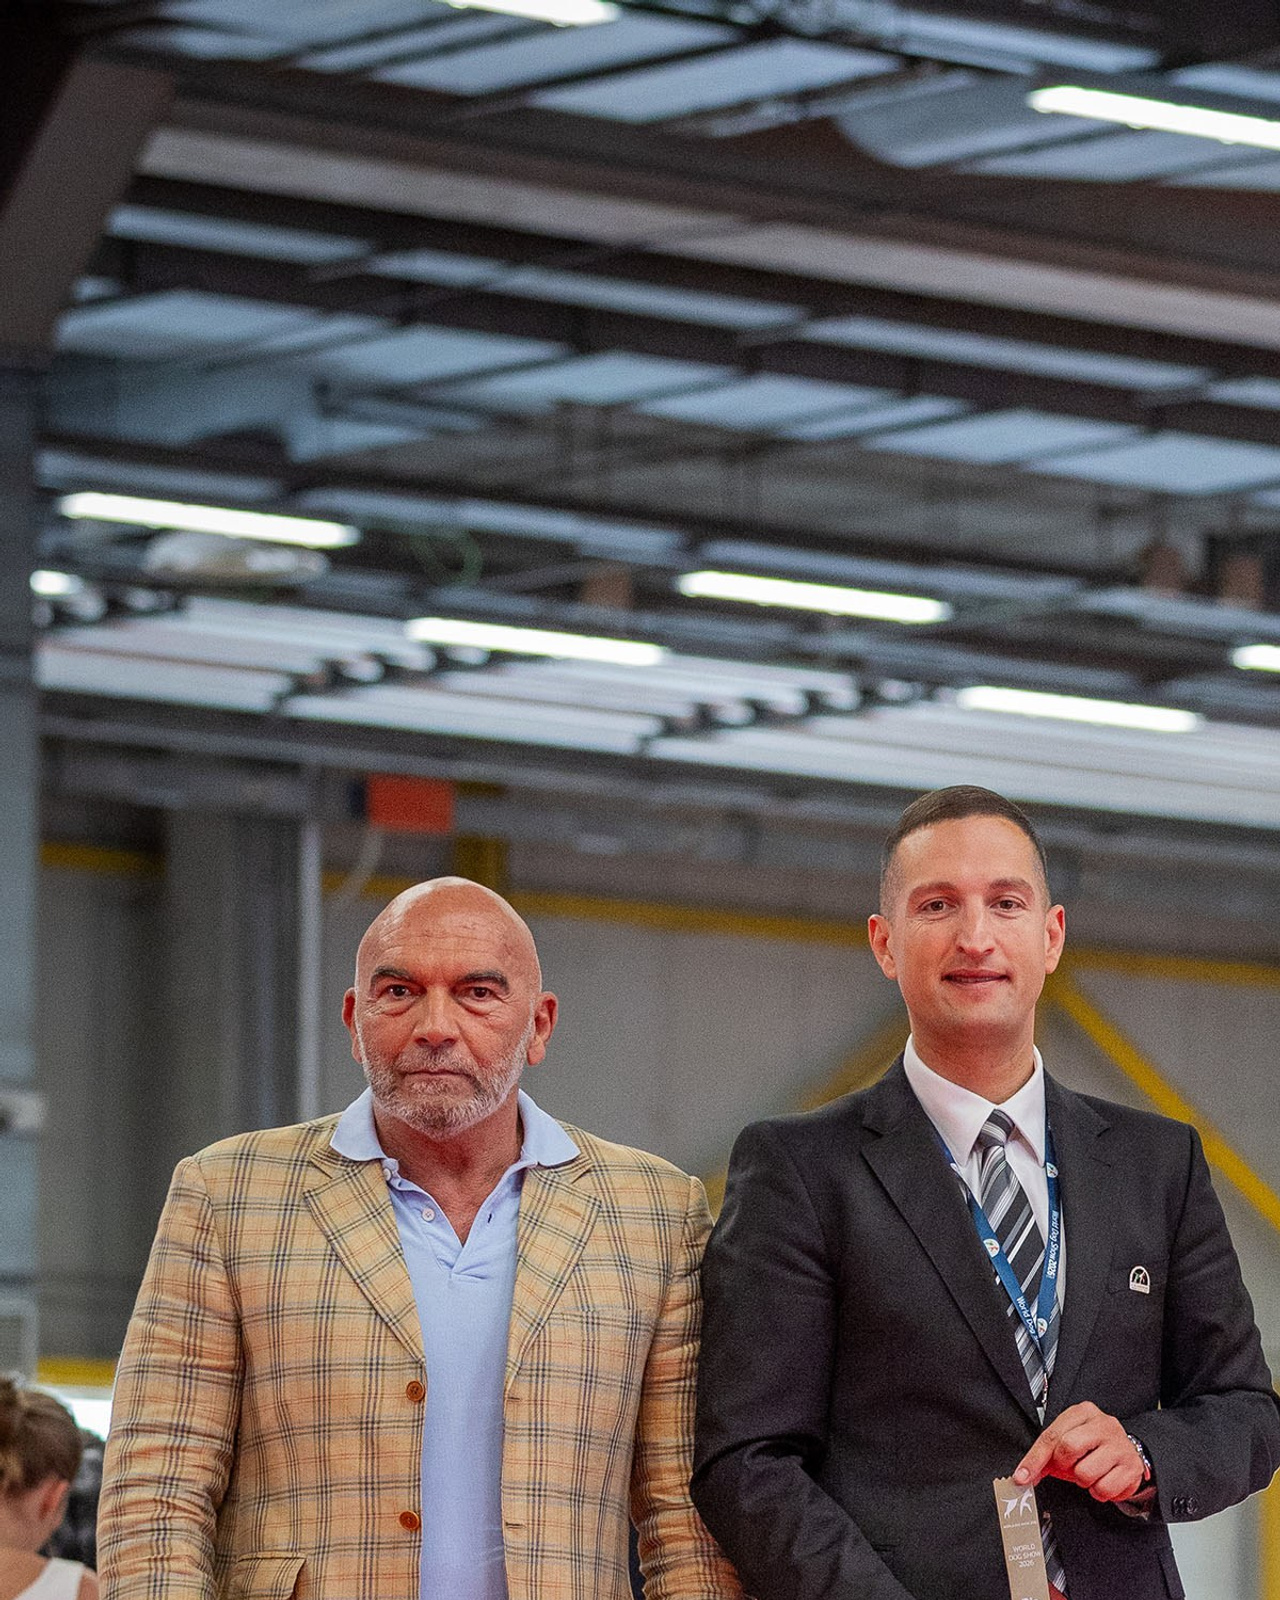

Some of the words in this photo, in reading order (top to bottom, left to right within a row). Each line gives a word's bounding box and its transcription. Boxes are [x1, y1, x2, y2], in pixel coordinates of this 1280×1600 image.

[1050, 1228, 1059, 1241] Dog
[1049, 1241, 1059, 1260] Show
[1047, 1259, 1058, 1277] 2026
[1017, 1296, 1030, 1317] World
[1026, 1319, 1036, 1334] Dog
[1012, 1543, 1036, 1553] WORLD
[1008, 1553, 1022, 1561] DOG
[1022, 1551, 1041, 1559] SHOW
[1018, 1560, 1034, 1568] 2026
